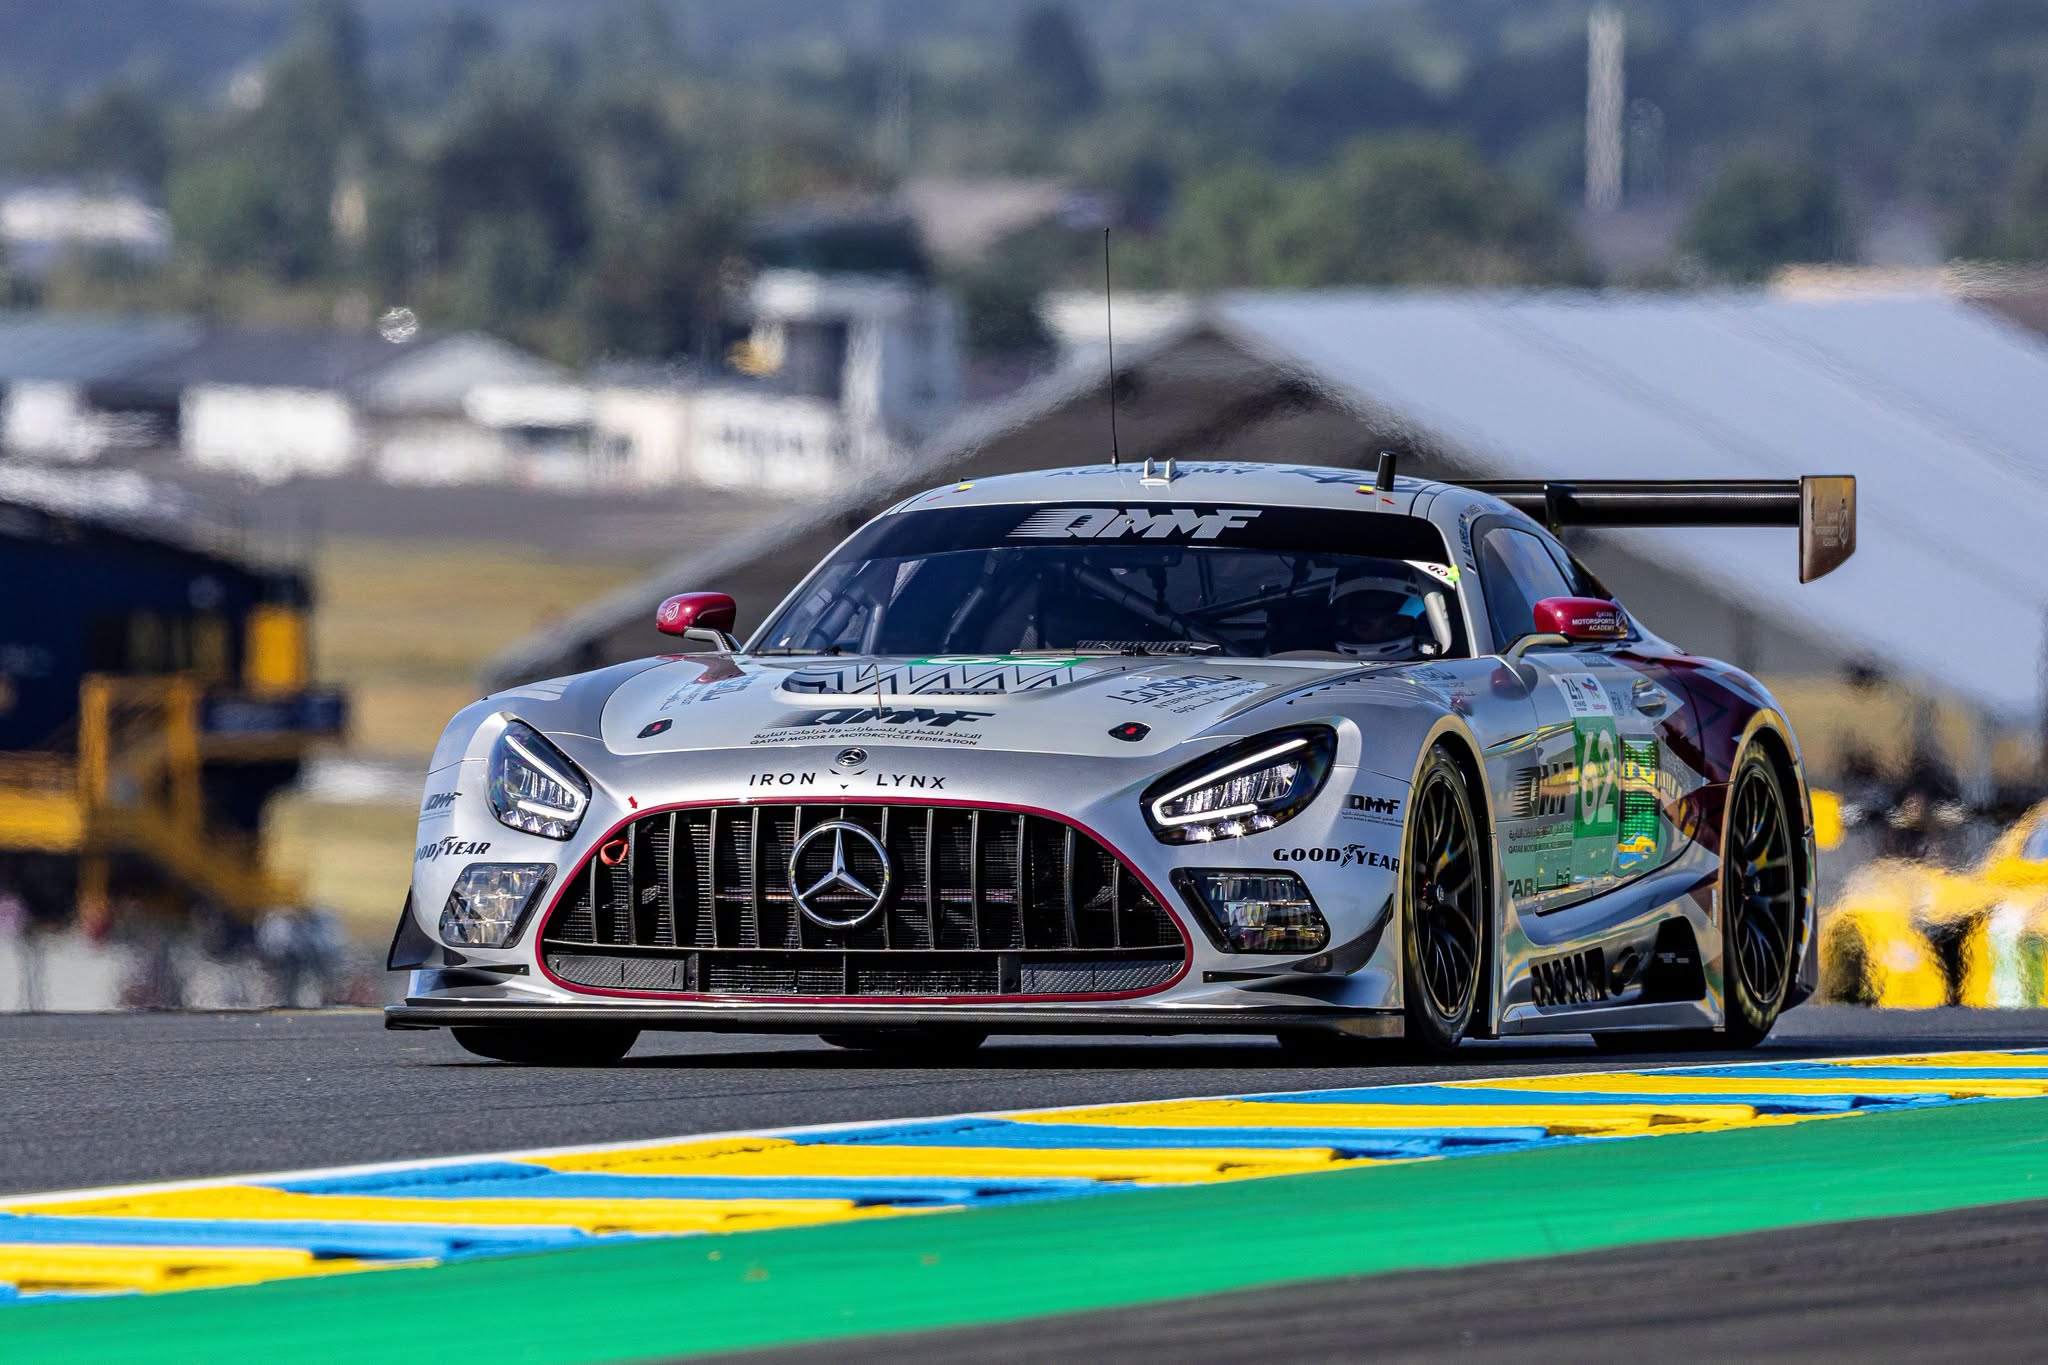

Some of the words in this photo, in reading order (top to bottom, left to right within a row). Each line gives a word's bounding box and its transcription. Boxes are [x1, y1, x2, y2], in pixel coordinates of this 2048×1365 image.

[1005, 508, 1262, 539] QMMF
[750, 737, 786, 745] QATAR
[787, 735, 825, 743] MOTOR
[838, 732, 911, 741] MOTORCYCLE
[912, 735, 978, 746] FEDERATION
[749, 772, 816, 787] IRON
[876, 773, 947, 789] LYNX
[1581, 729, 1617, 825] 62
[1342, 794, 1401, 815] QMMF
